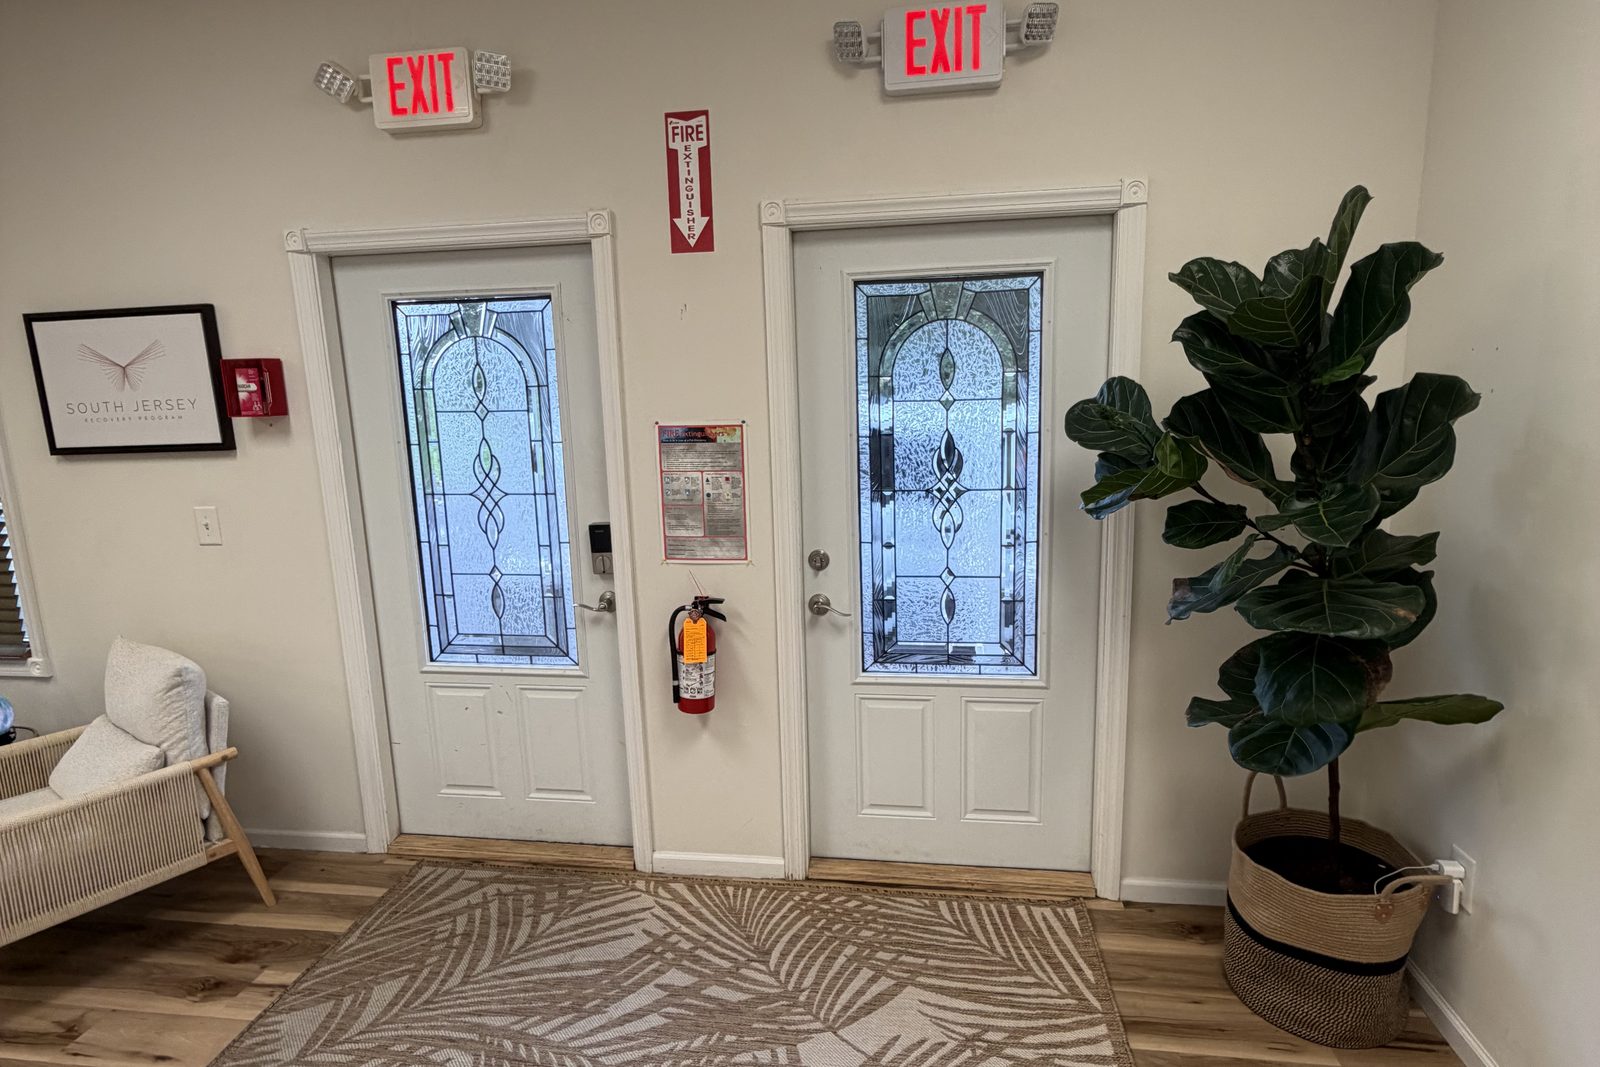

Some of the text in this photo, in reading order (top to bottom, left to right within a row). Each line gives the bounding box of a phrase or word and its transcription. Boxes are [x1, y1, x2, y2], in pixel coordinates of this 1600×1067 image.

[904, 4, 987, 76] EXIT
[386, 52, 455, 116] EXIT
[671, 124, 704, 143] FIRE
[683, 145, 696, 240] EXTINGUISHER
[66, 399, 197, 414] SOUTH JERSEY
